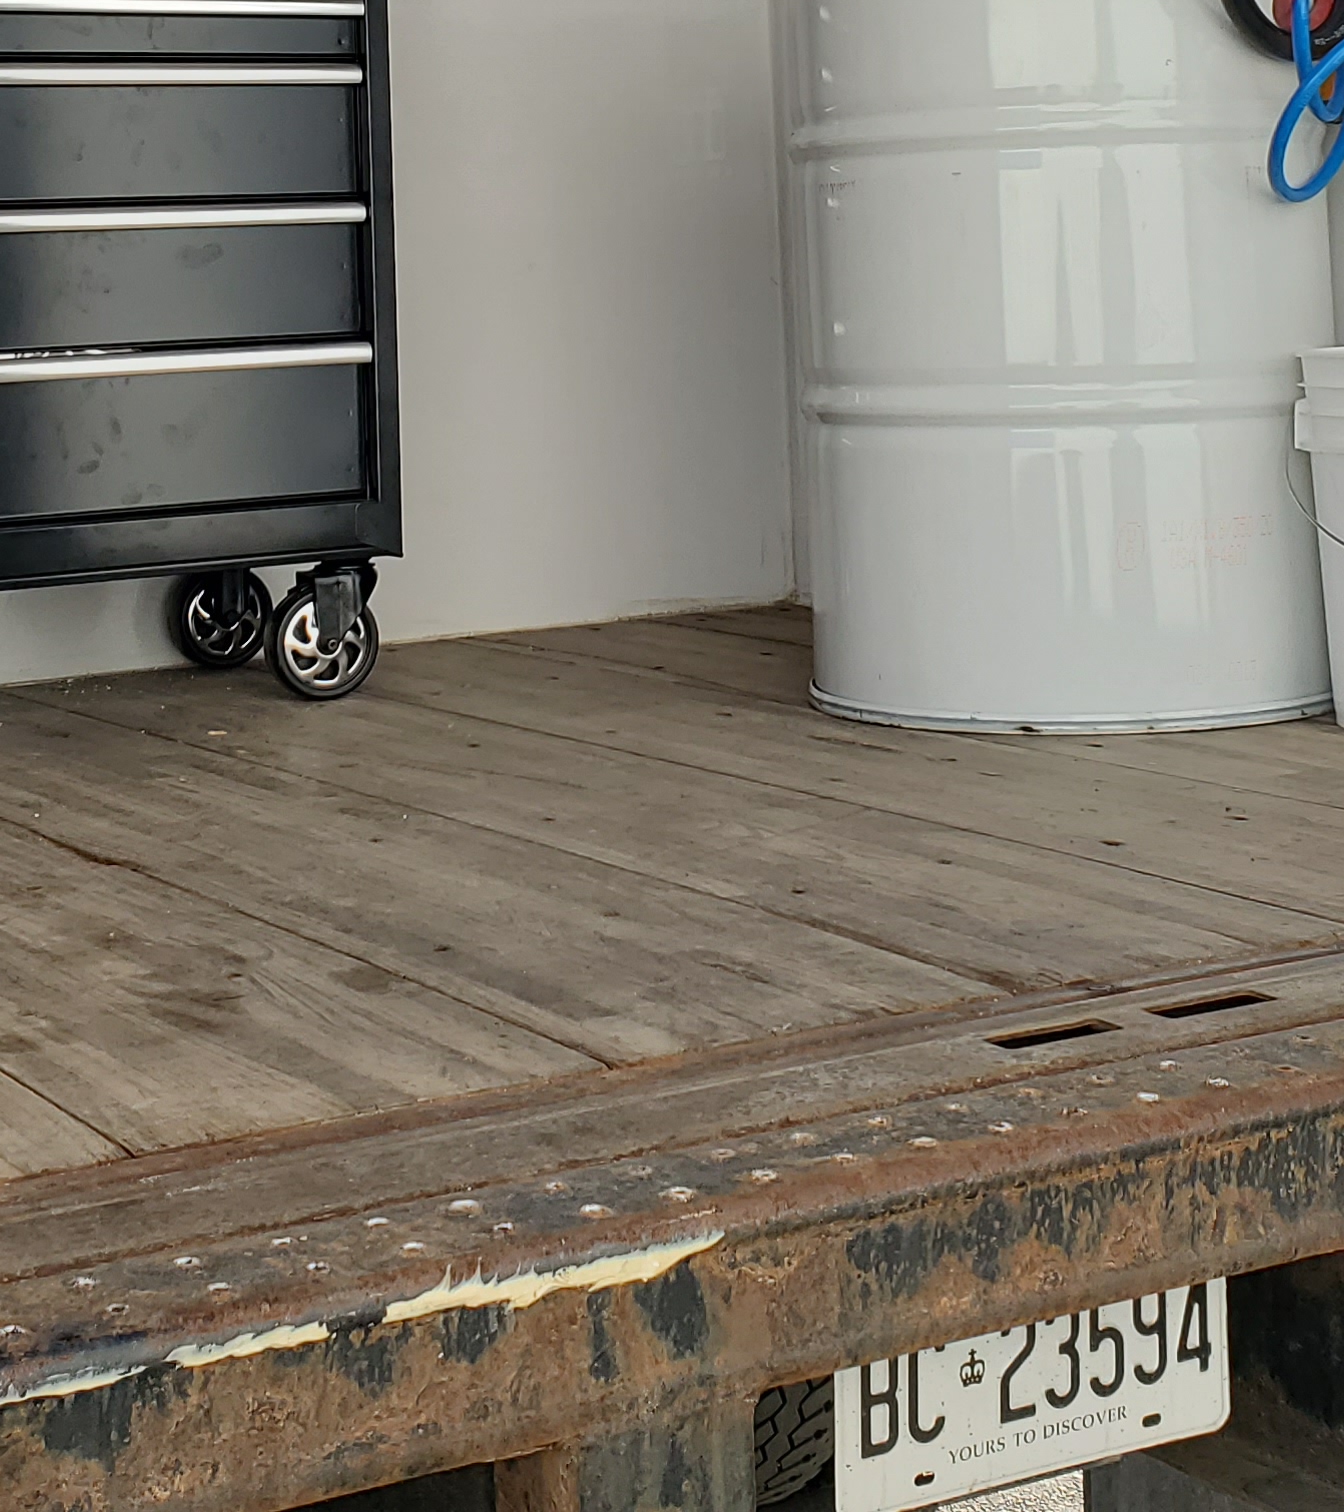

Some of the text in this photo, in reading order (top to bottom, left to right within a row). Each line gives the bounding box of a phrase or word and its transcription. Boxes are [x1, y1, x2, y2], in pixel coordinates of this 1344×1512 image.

[860, 1281, 1212, 1459] BC 23594
[949, 1405, 1128, 1464] YOURS TO DISCOVER
